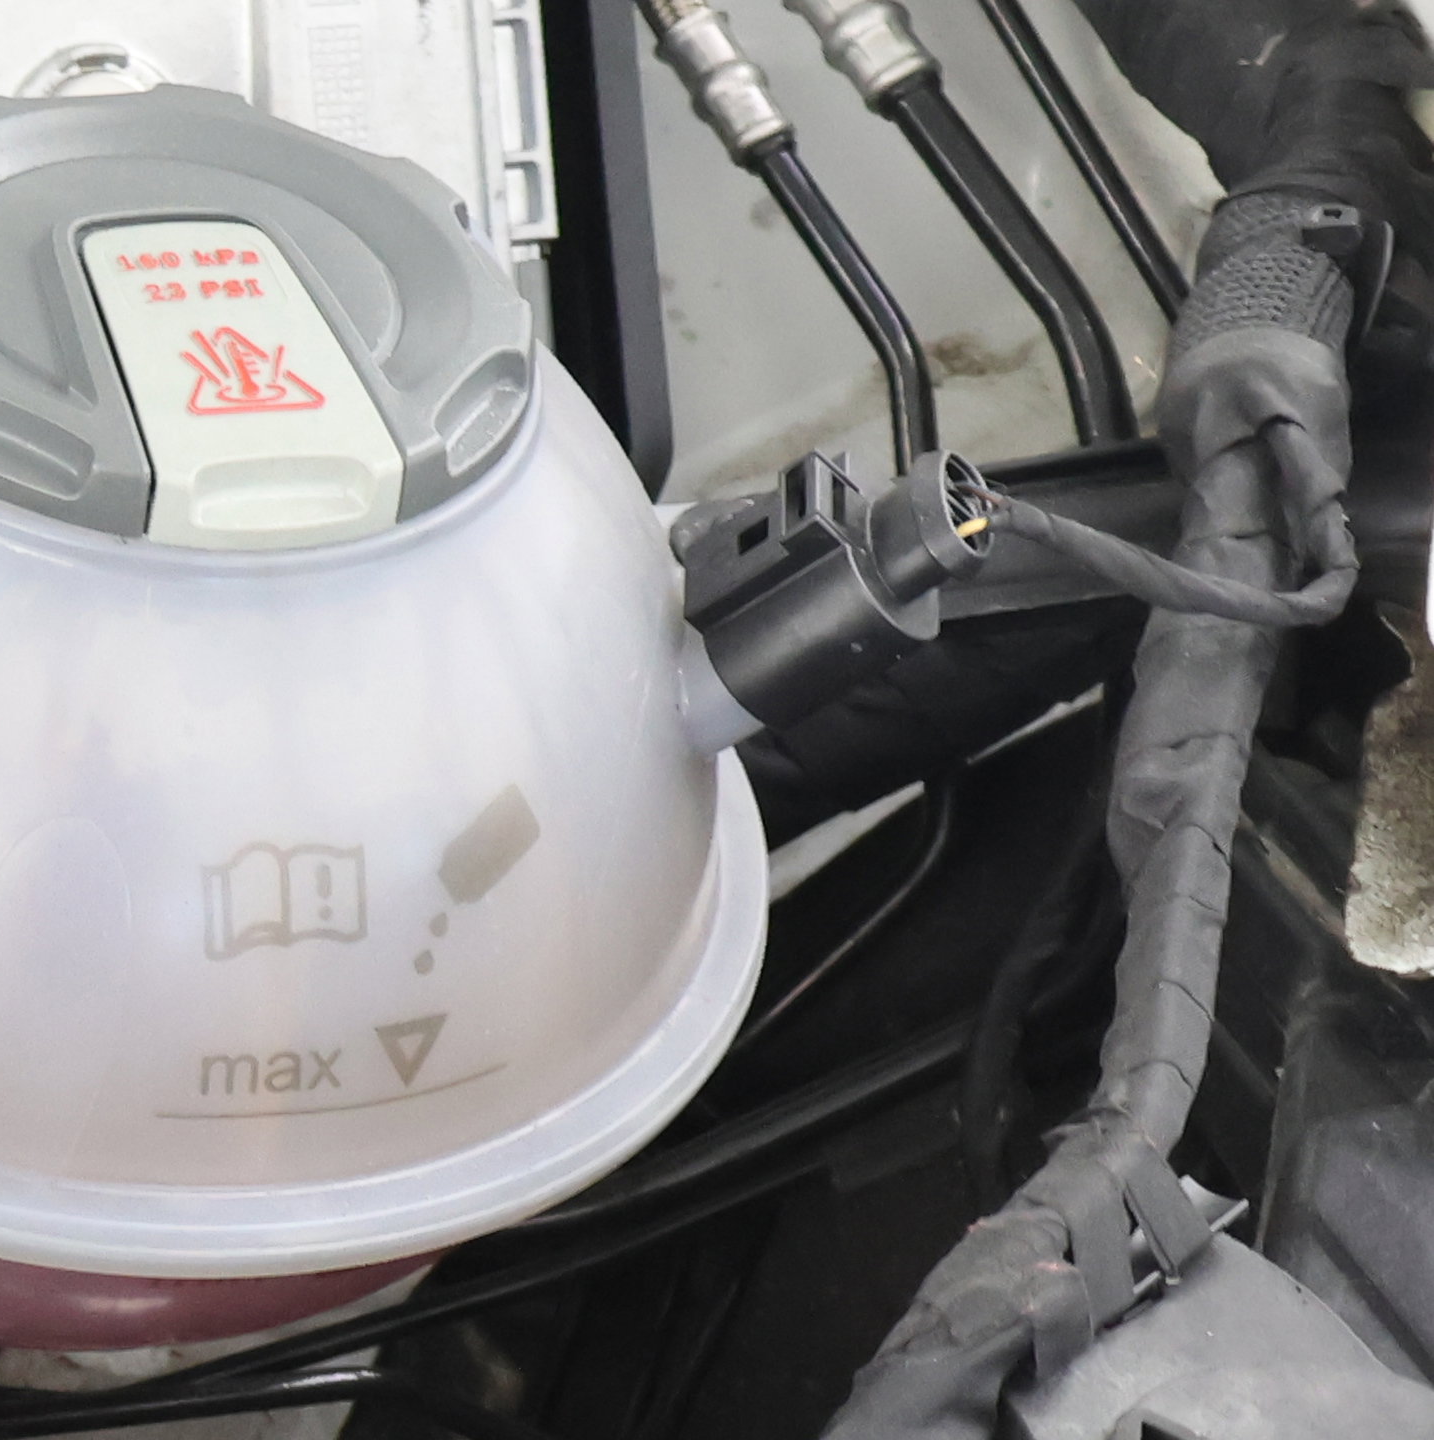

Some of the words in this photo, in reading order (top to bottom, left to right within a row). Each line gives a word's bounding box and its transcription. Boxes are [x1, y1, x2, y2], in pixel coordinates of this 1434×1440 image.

[192, 248, 260, 266] kPa
[145, 282, 187, 302] 23
[200, 278, 265, 298] PSI
[200, 1047, 342, 1096] max
